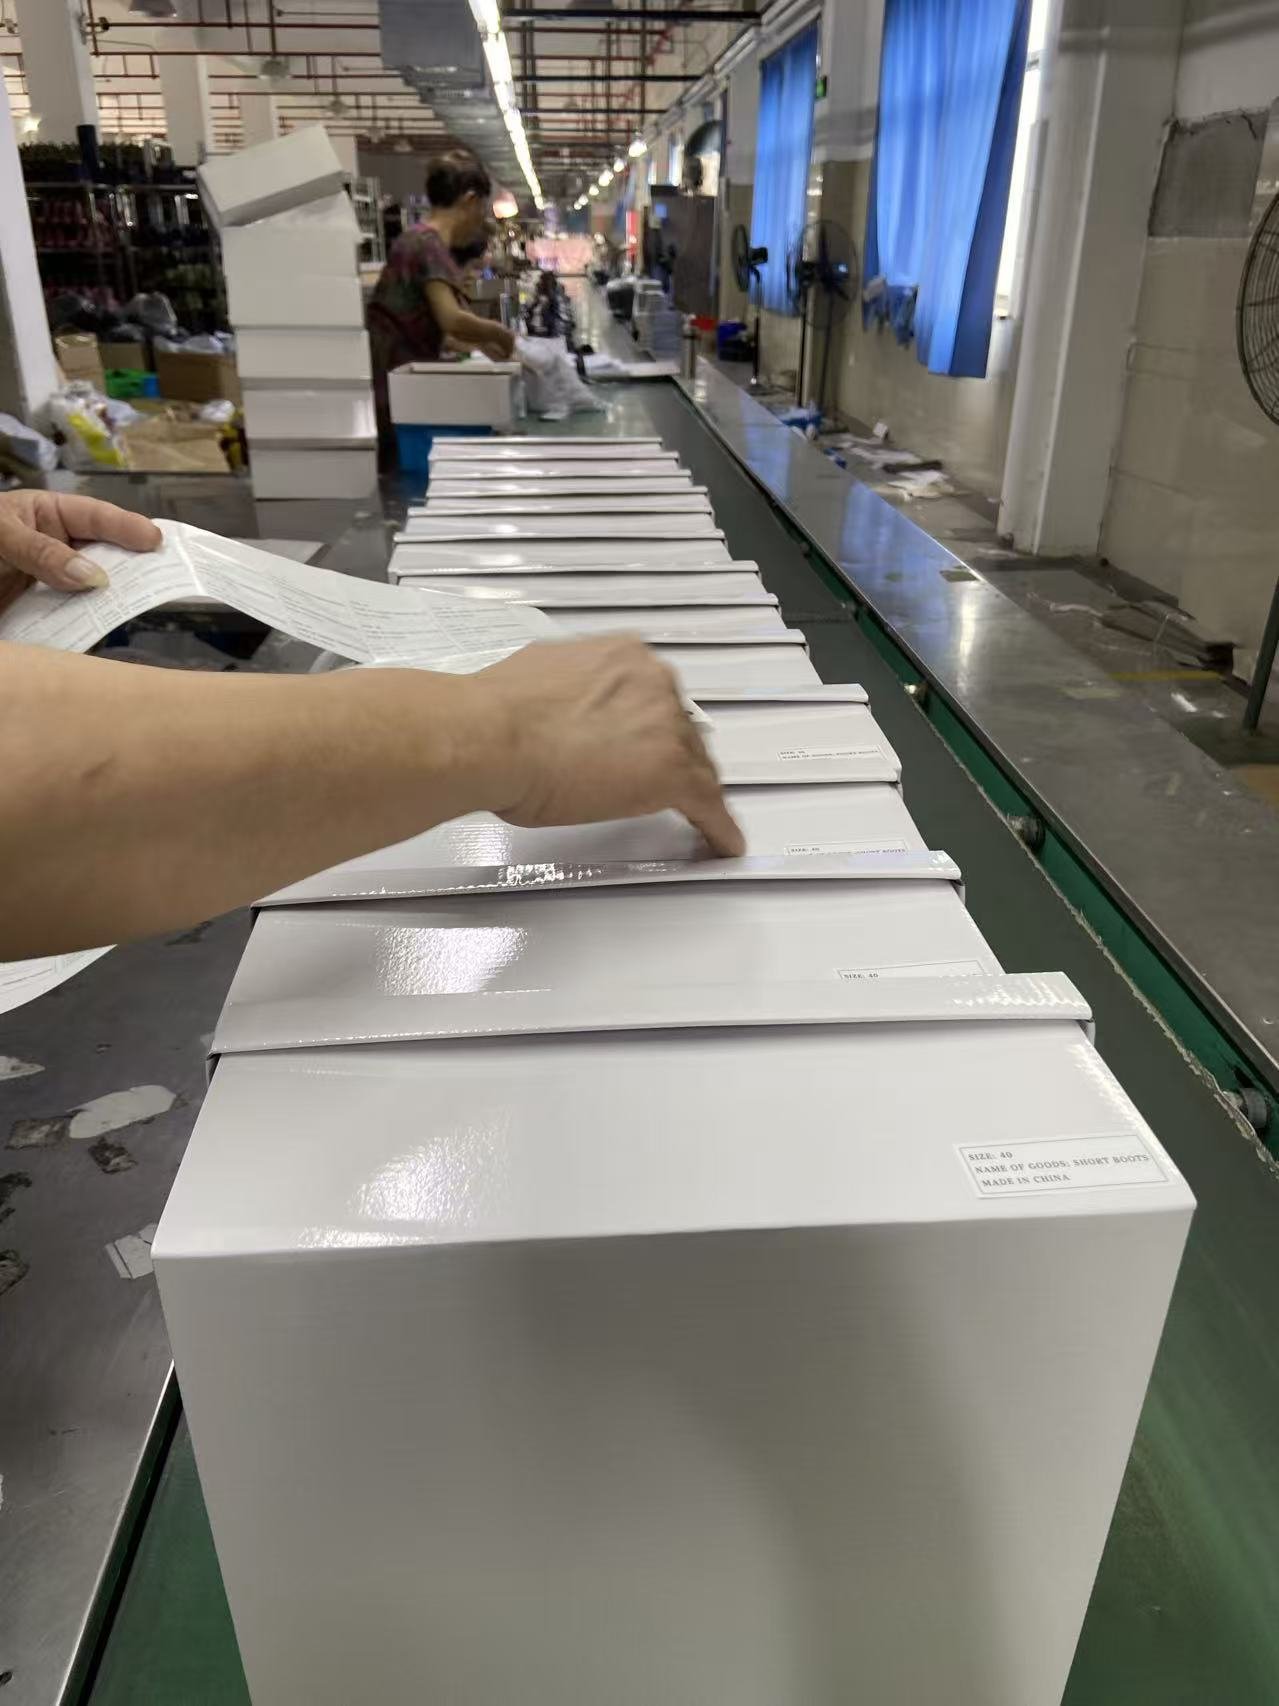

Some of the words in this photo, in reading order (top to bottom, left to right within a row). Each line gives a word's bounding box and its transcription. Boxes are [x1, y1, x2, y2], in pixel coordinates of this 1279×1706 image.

[968, 1151, 995, 1161] SIZE:
[1000, 1151, 1013, 1160] 40
[975, 1163, 1007, 1174] NAME
[1010, 1162, 1025, 1172] OF
[1073, 1156, 1110, 1167] SHORT
[1114, 1153, 1150, 1164] BOOTS
[983, 1177, 1015, 1188] MADE
[1017, 1175, 1031, 1185] IN
[1033, 1173, 1070, 1184] CHINA
